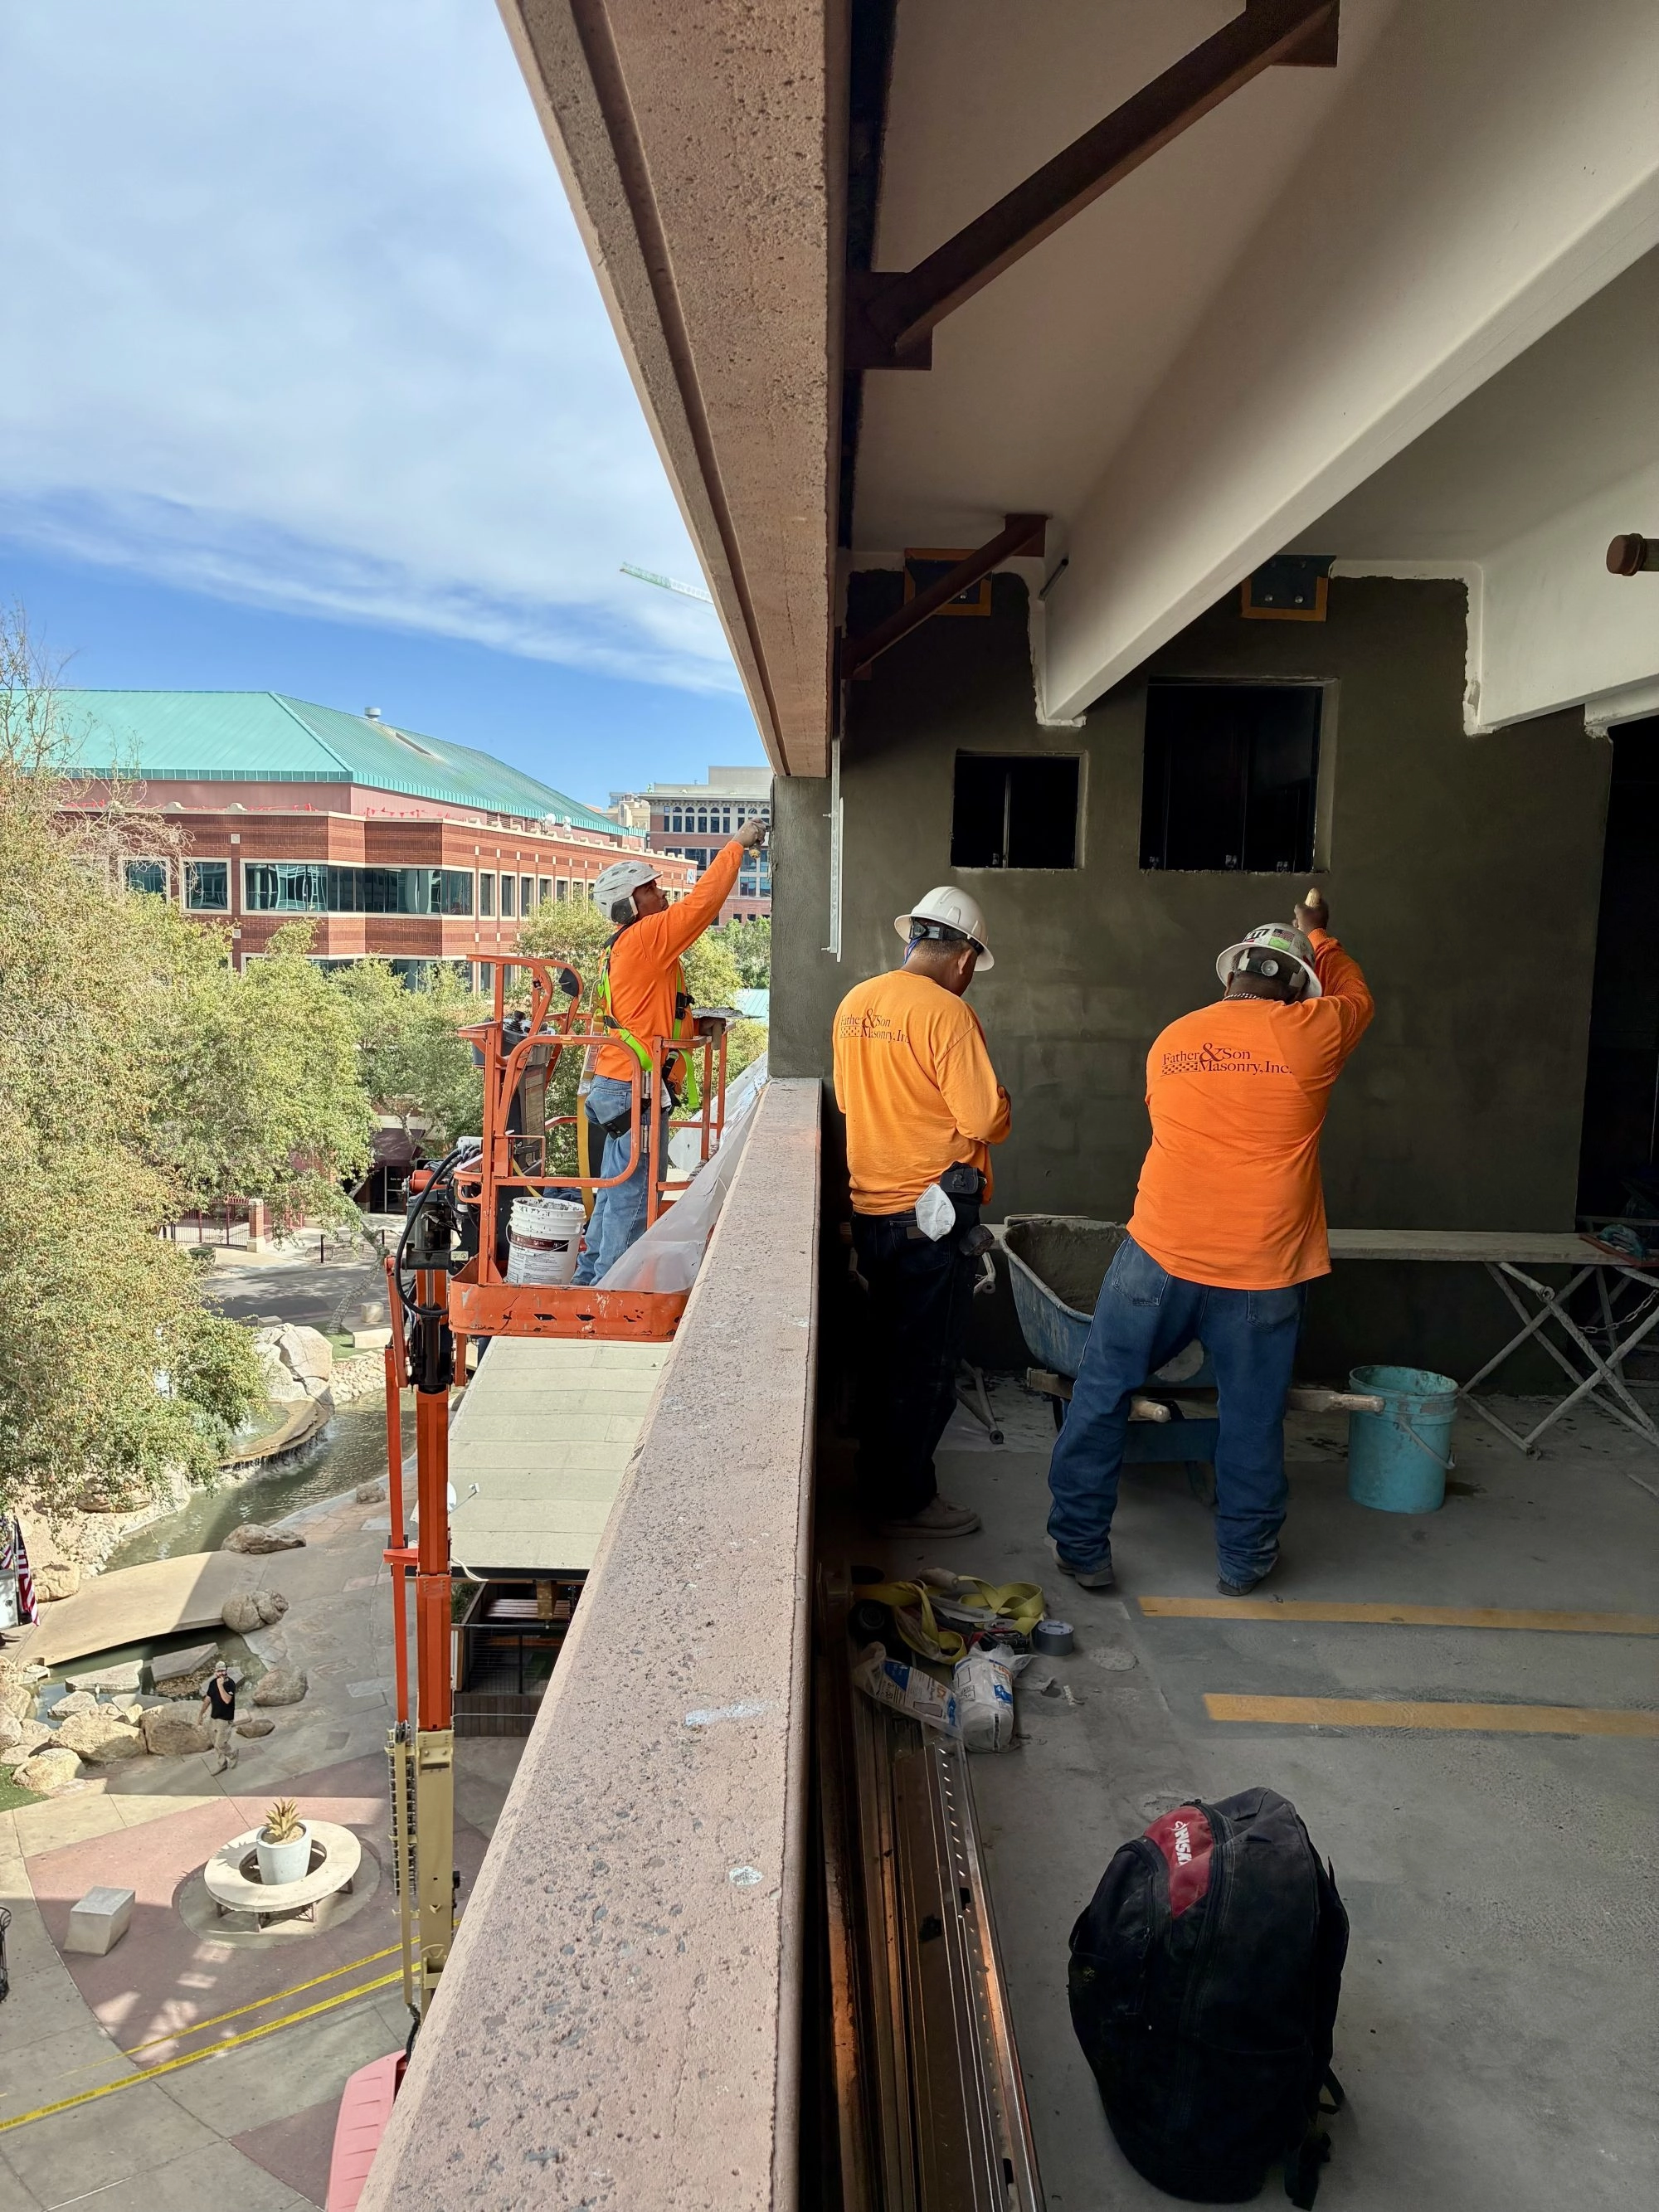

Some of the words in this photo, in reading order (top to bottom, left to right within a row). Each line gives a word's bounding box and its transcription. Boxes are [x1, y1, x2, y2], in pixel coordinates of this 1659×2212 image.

[840, 1014, 863, 1026] Father
[862, 1008, 879, 1028] &
[875, 1014, 891, 1028] Son
[1163, 1050, 1200, 1065] Father
[1199, 1043, 1224, 1062] &
[1223, 1047, 1251, 1060] Son
[1199, 1060, 1263, 1076] Masonry,
[1265, 1060, 1292, 1074] Inc.
